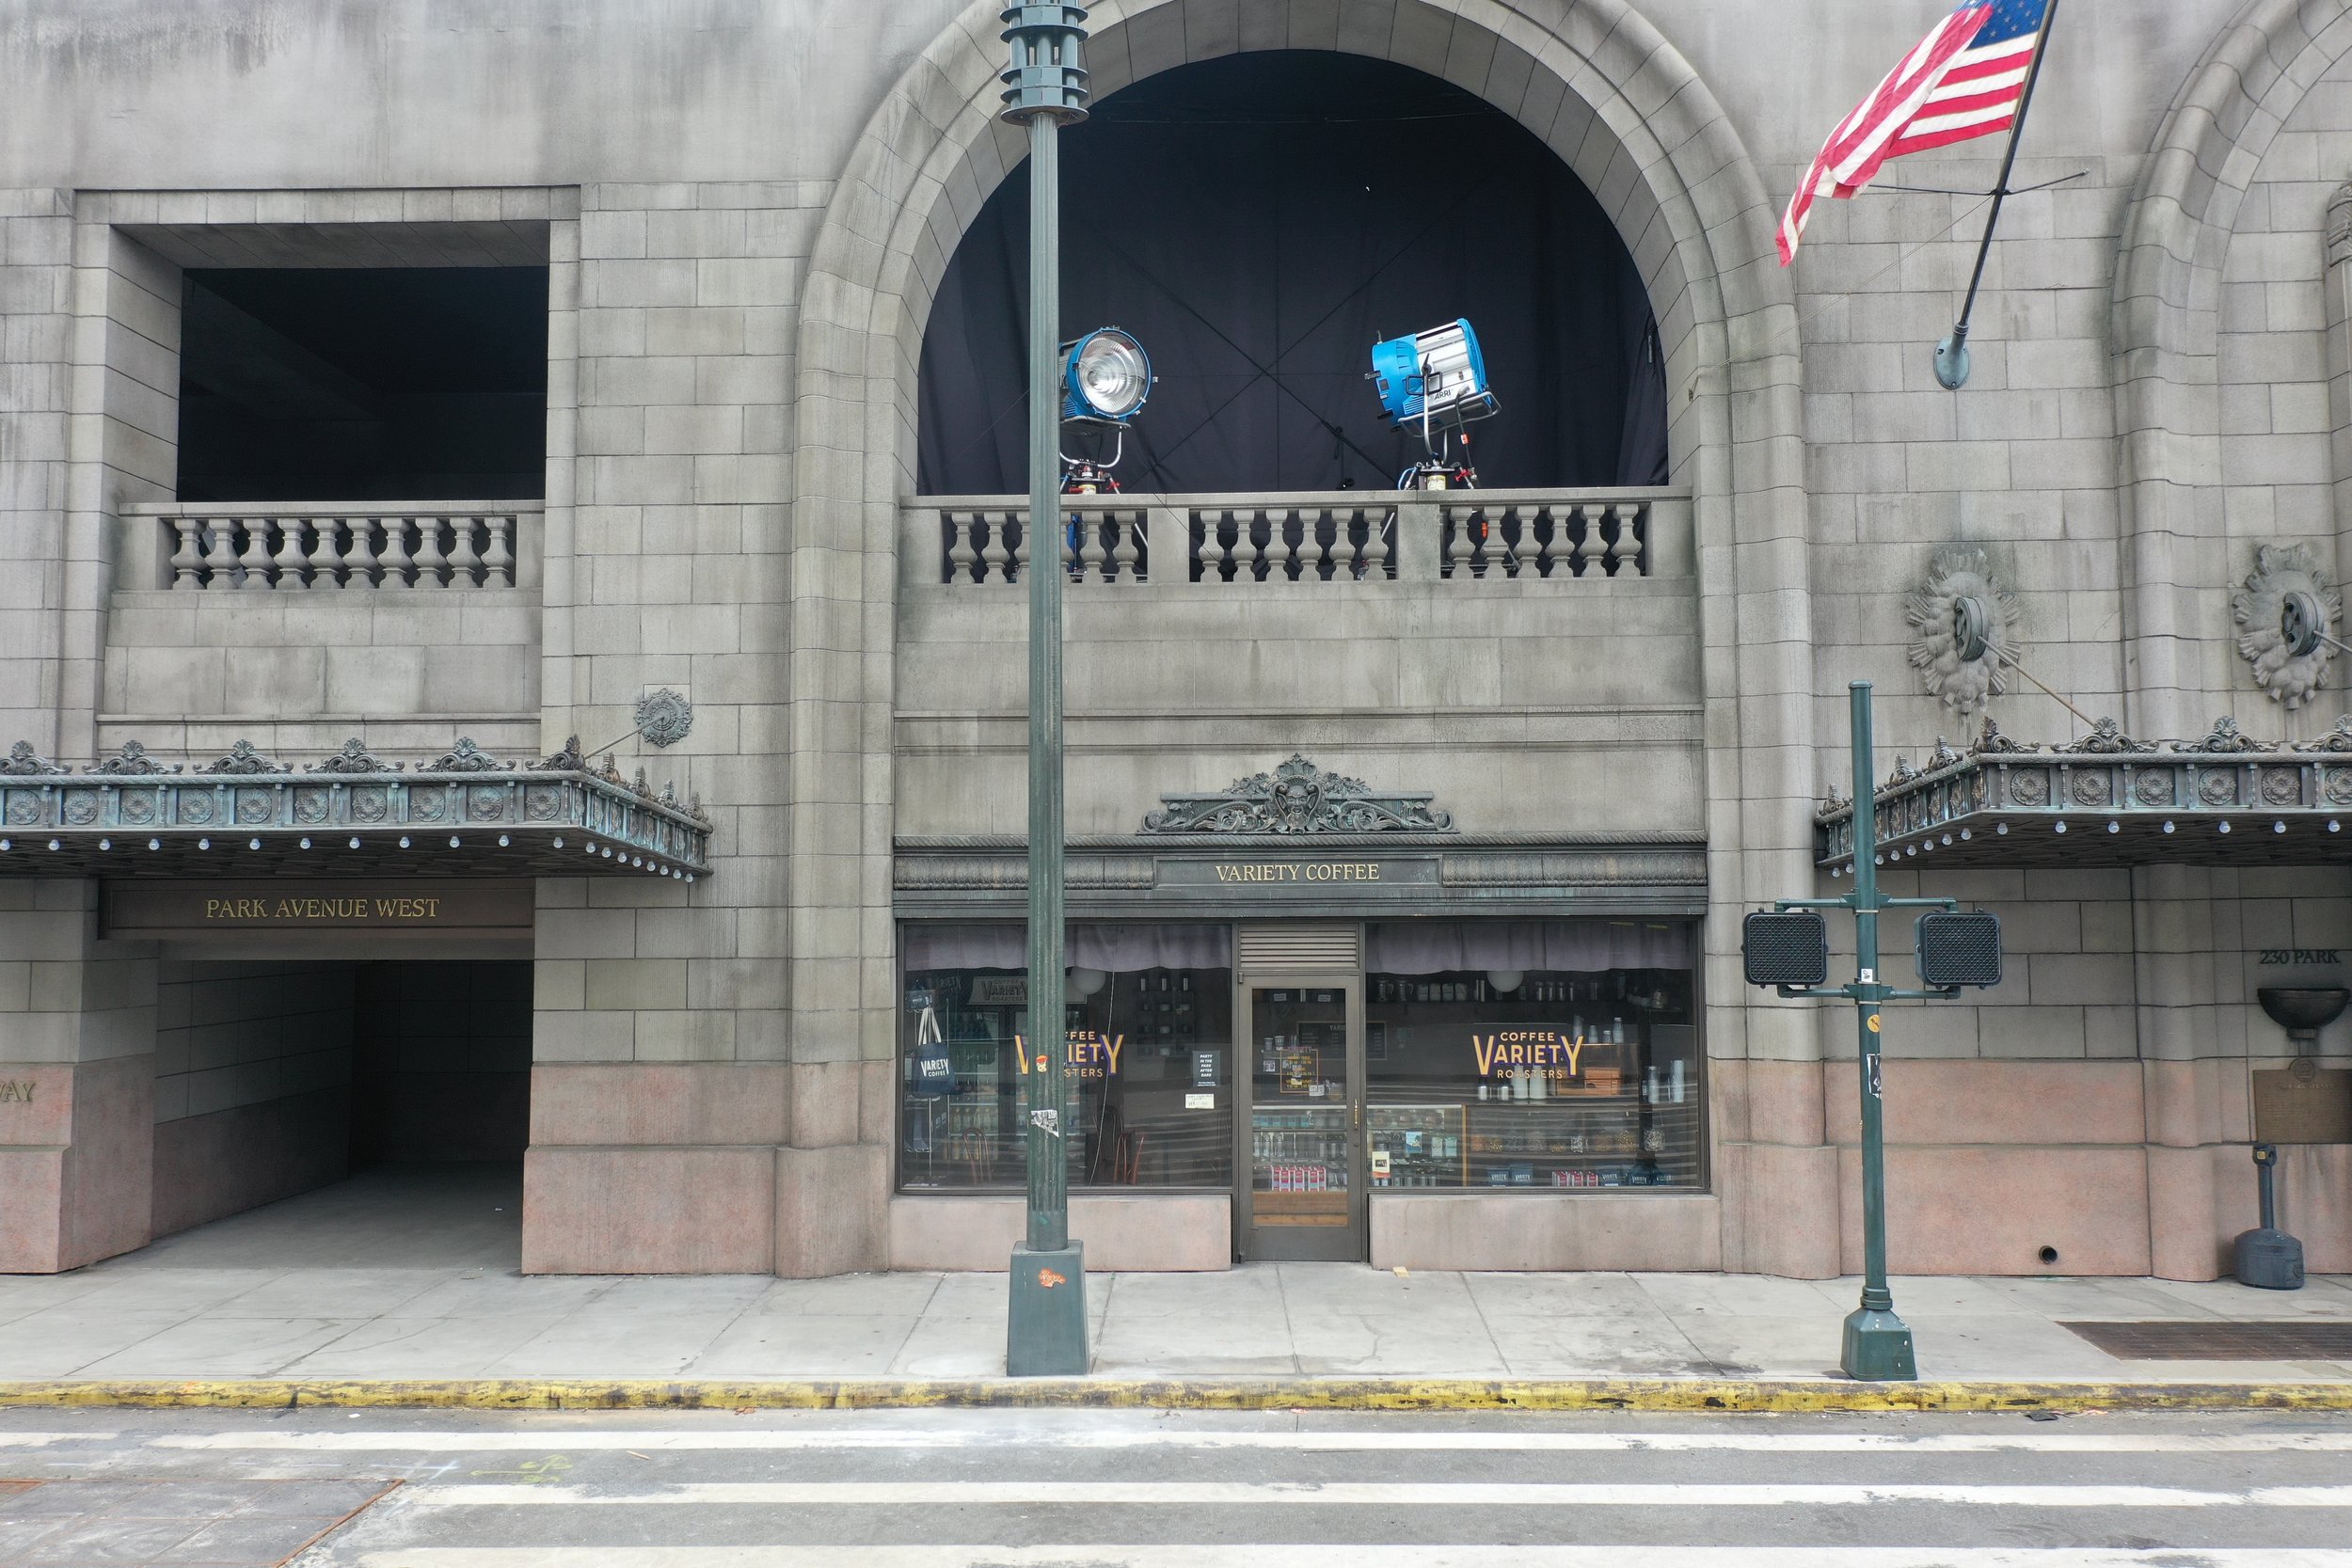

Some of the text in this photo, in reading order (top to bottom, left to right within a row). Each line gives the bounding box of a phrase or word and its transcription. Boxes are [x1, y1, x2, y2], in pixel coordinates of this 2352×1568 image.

[1434, 388, 1452, 401] ARRI
[1216, 863, 1380, 881] VARIETY COFFEE
[205, 897, 440, 918] PARK AVENUE WEST
[2260, 950, 2341, 964] 230 PARK
[1065, 1031, 1096, 1040] FEE
[1500, 1032, 1555, 1041] COFFEE
[1014, 1035, 1124, 1075] VIETY
[1472, 1035, 1584, 1076] VARIETY
[920, 1058, 949, 1077] VARIETY
[1064, 1069, 1103, 1078] STERS
[1497, 1069, 1563, 1079] ROASTERS
